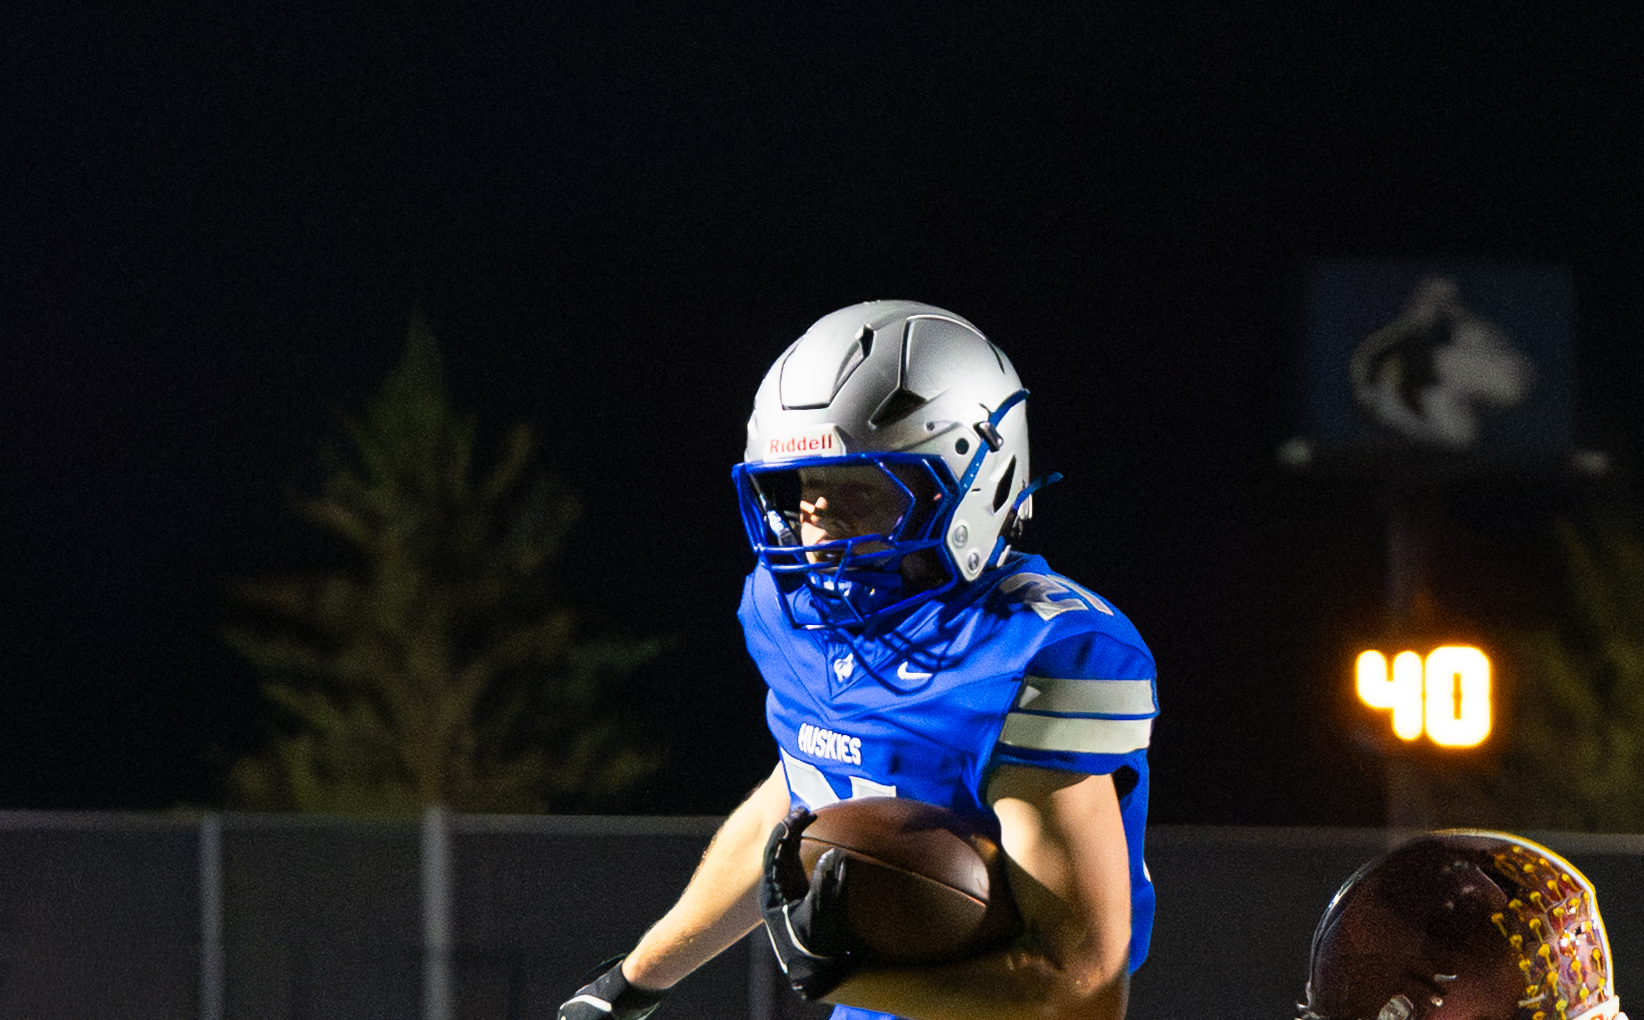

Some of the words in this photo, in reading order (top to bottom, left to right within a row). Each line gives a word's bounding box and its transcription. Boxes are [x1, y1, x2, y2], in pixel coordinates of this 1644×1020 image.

[769, 433, 833, 454] Riddell
[1355, 645, 1492, 747] 40
[797, 722, 862, 766] HUSKIES
